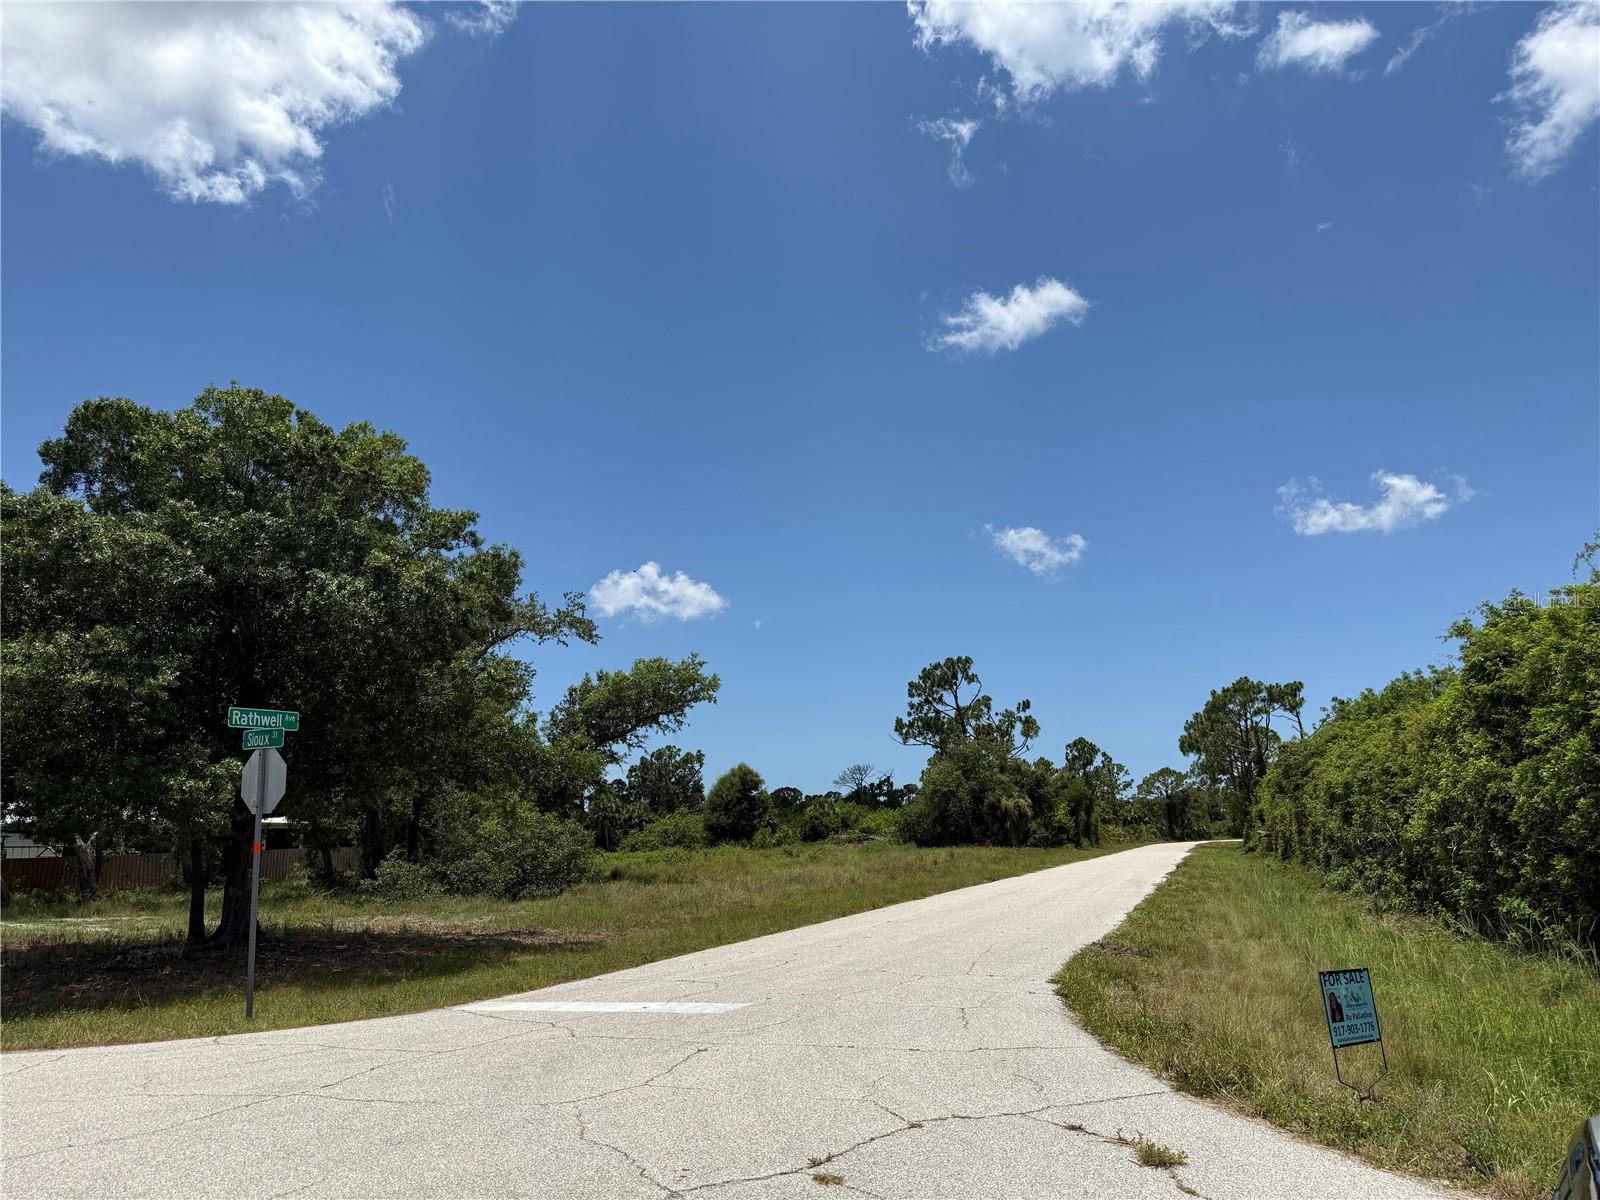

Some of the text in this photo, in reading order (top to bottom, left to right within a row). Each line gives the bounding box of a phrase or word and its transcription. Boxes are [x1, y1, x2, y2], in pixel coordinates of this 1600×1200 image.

[232, 710, 296, 727] Rathwell Ave
[247, 730, 278, 747] Sioux St
[1322, 971, 1365, 987] FOR SALE
[1333, 1021, 1376, 1037] 917-903-1776
